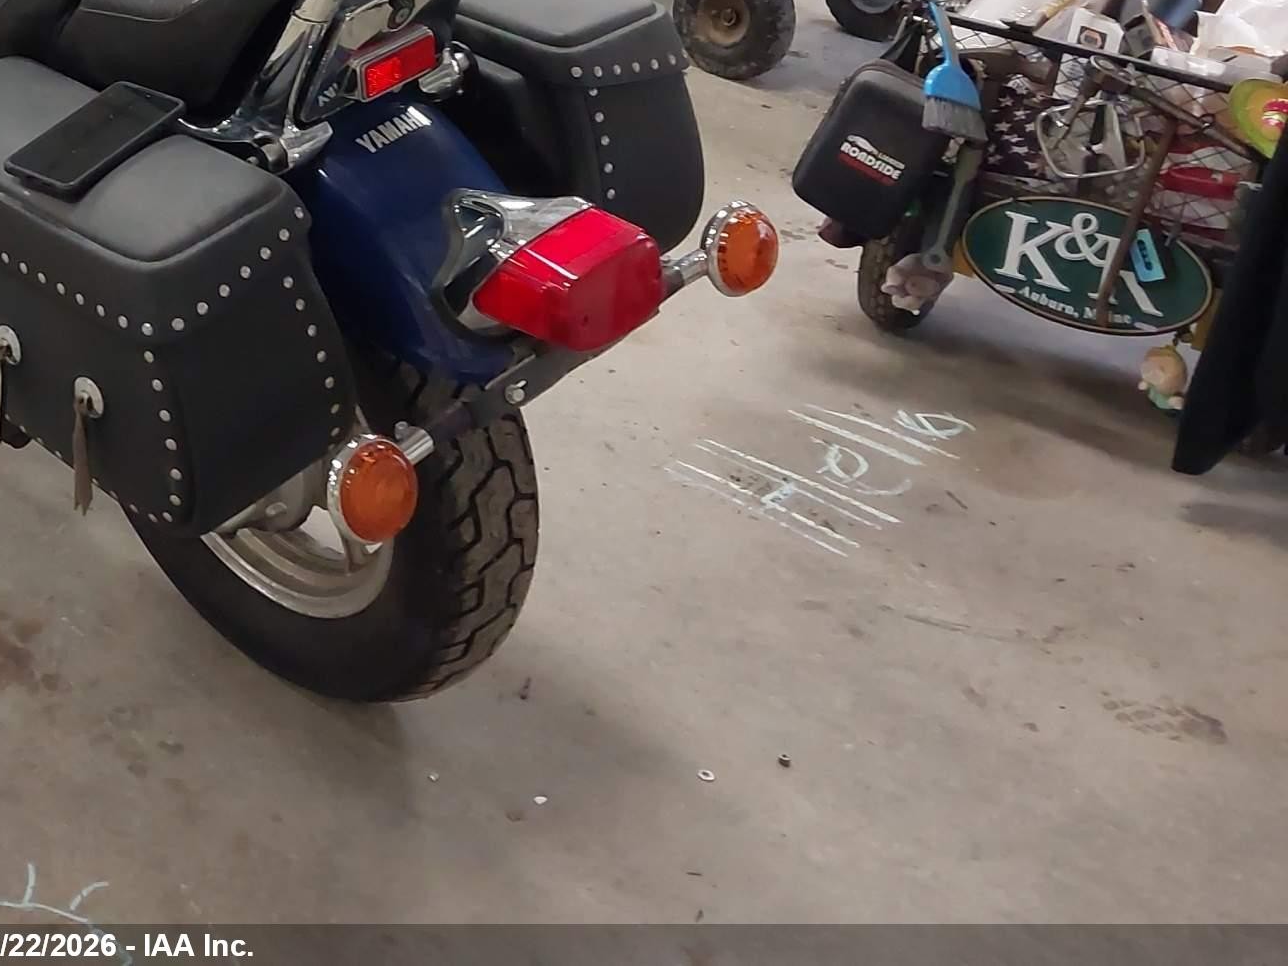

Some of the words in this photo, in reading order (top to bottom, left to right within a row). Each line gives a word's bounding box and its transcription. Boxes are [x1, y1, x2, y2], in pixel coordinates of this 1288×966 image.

[354, 105, 433, 153] YAMAHA
[839, 141, 903, 180] ROADSIDE
[1018, 285, 1080, 319] Auburn,
[1083, 305, 1132, 324] Mine
